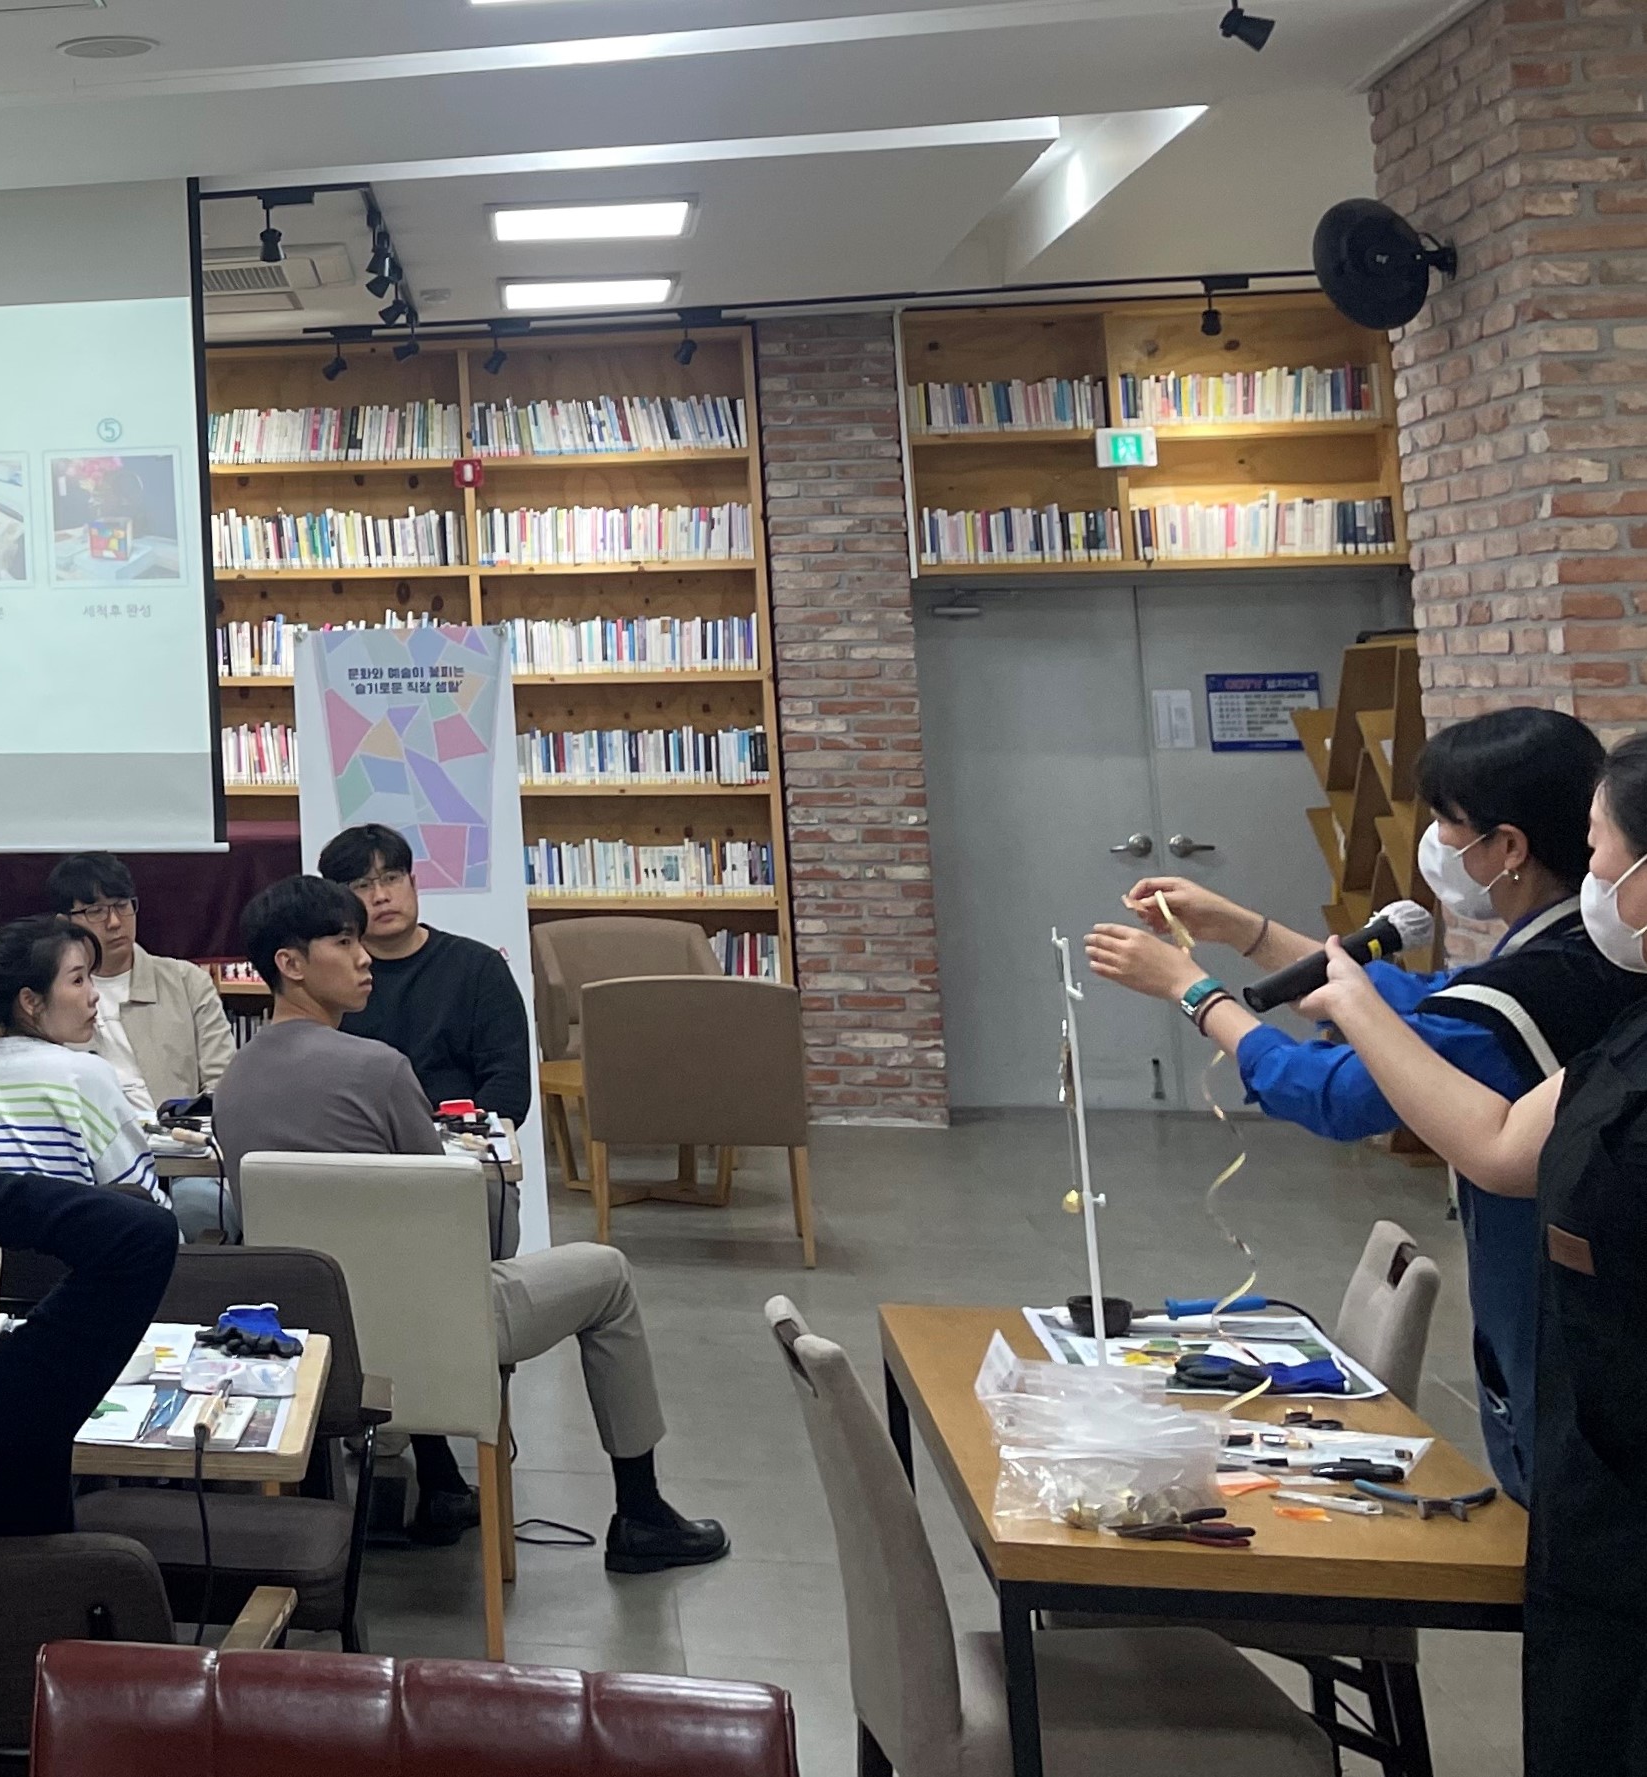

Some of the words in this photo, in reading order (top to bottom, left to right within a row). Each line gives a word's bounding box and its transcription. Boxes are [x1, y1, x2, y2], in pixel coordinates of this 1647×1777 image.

[126, 604, 151, 618] 완성
[348, 667, 384, 680] 문화와
[388, 666, 424, 679] 예술이
[429, 666, 464, 678] 꽃피는
[407, 681, 431, 694] 직장
